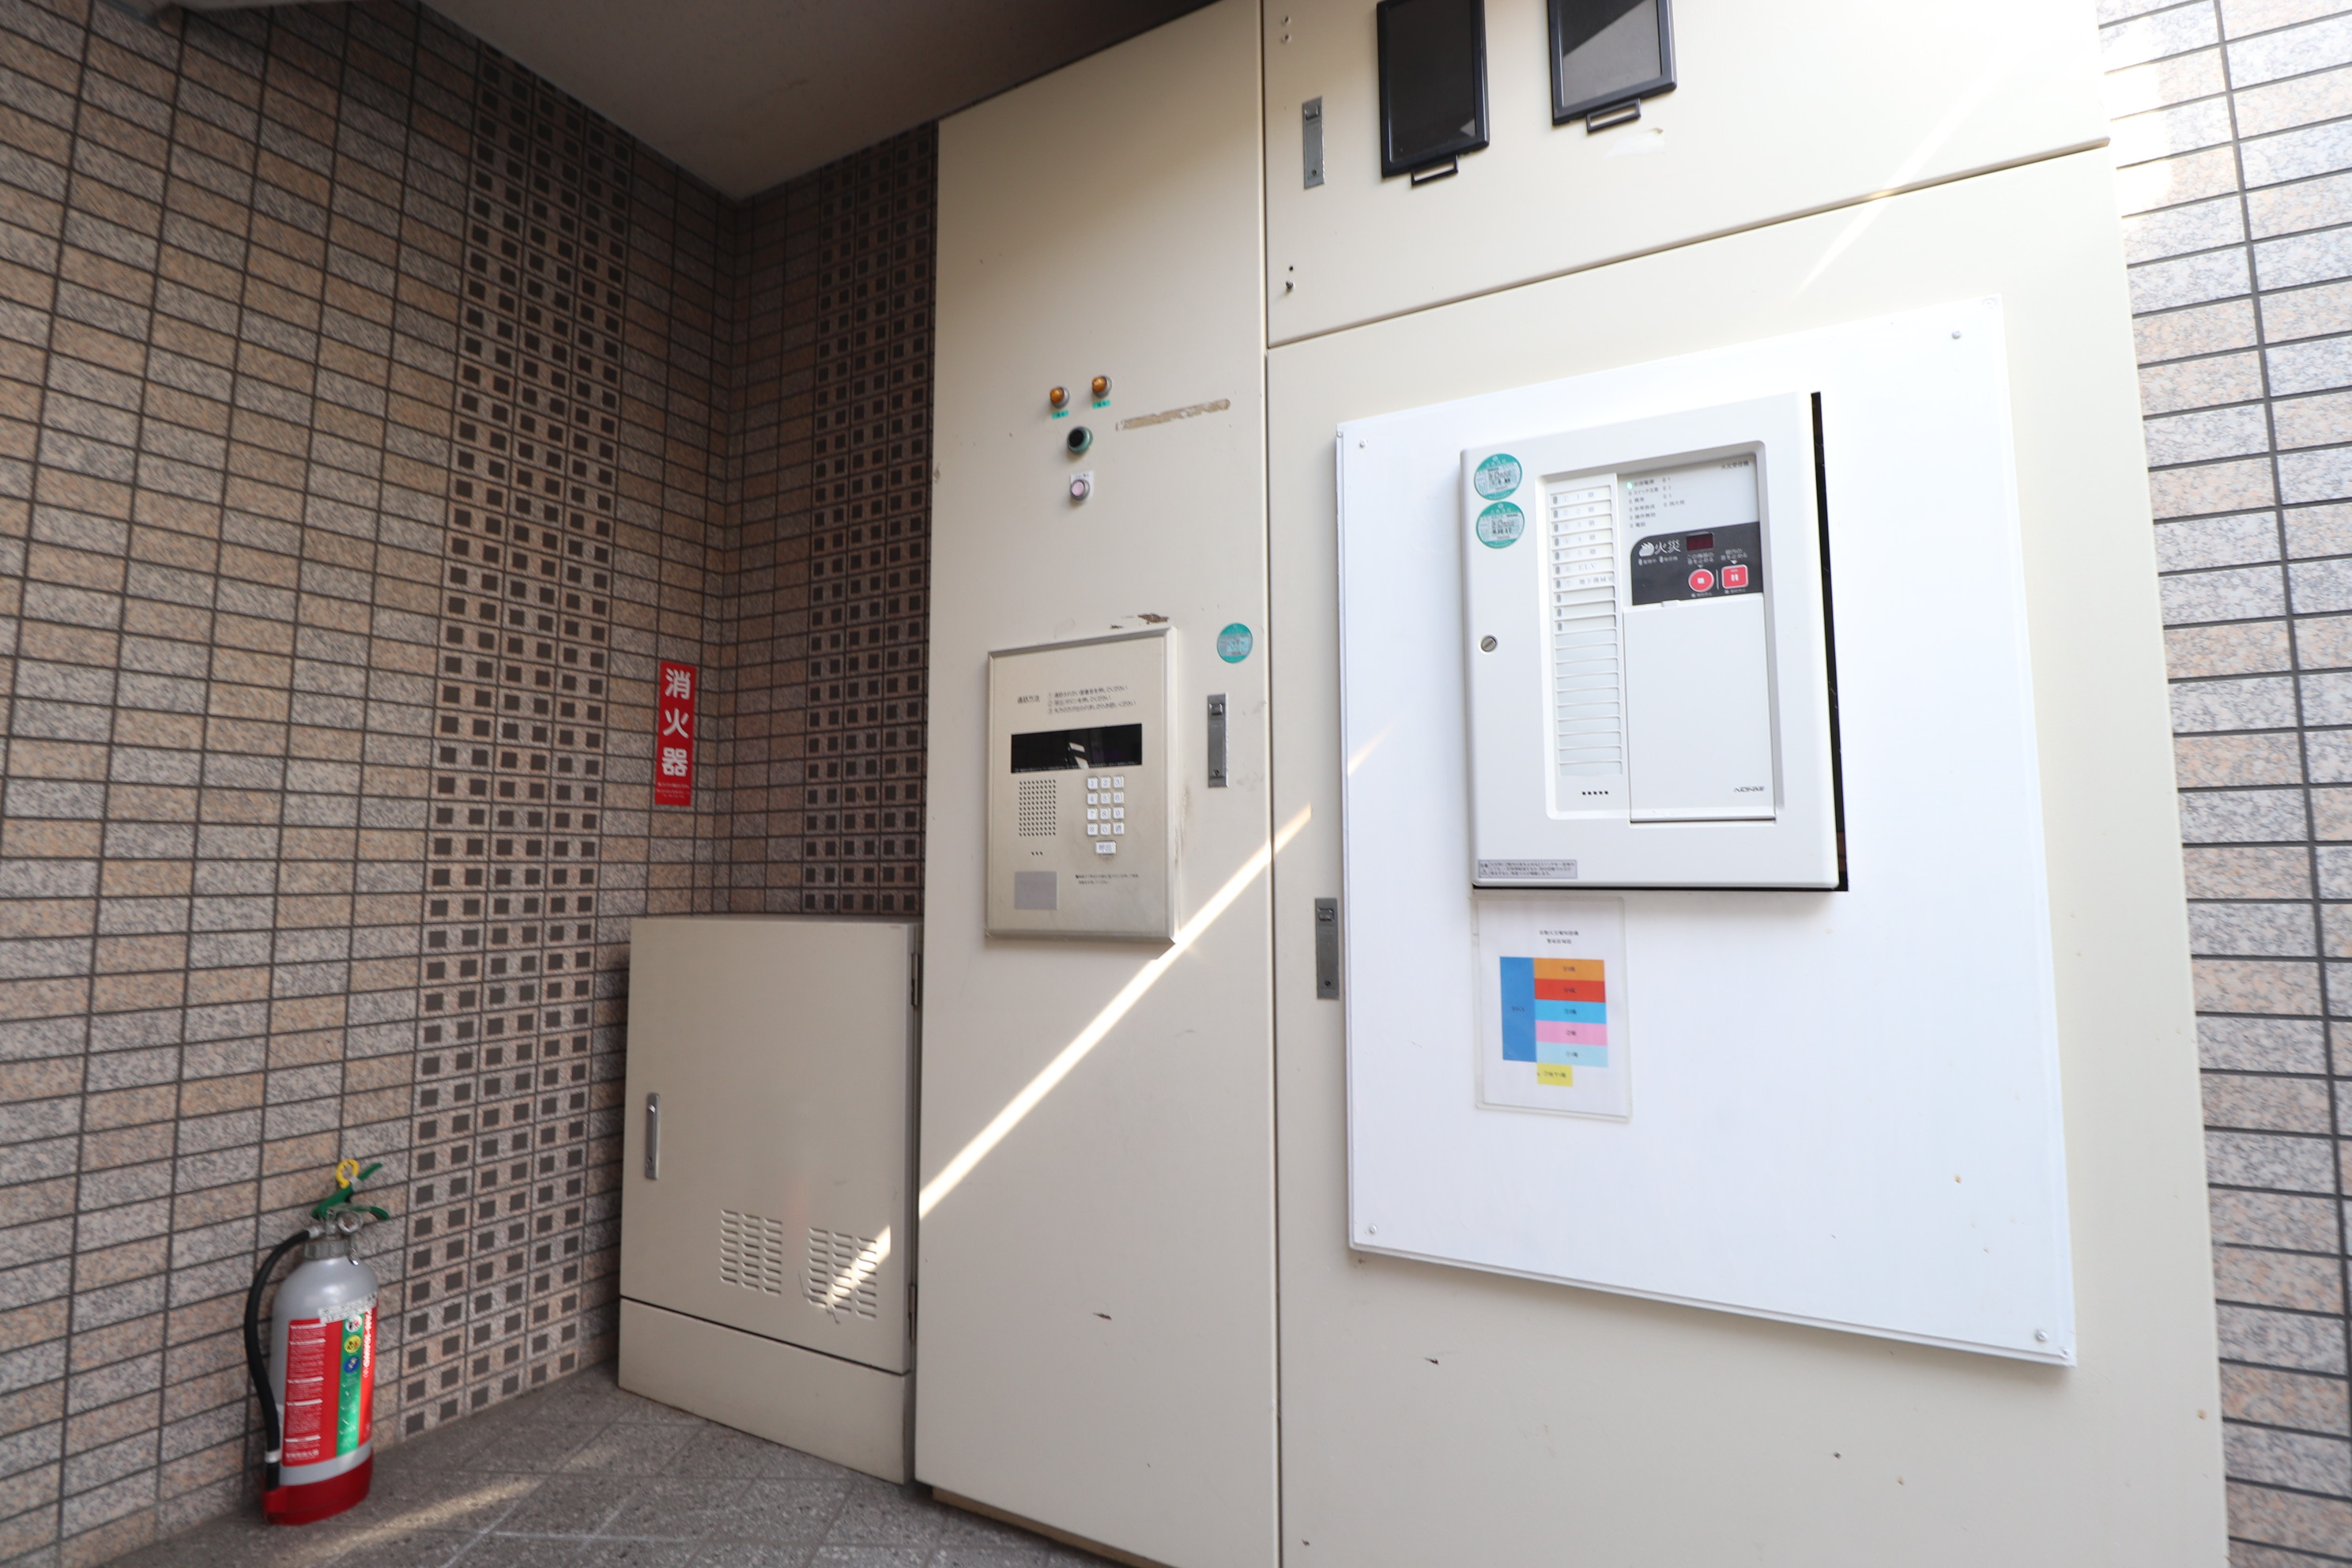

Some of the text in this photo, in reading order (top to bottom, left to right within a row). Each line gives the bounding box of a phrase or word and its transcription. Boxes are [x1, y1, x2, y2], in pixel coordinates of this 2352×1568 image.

[1654, 539, 1681, 556] 火災
[662, 667, 692, 778] 消火器
